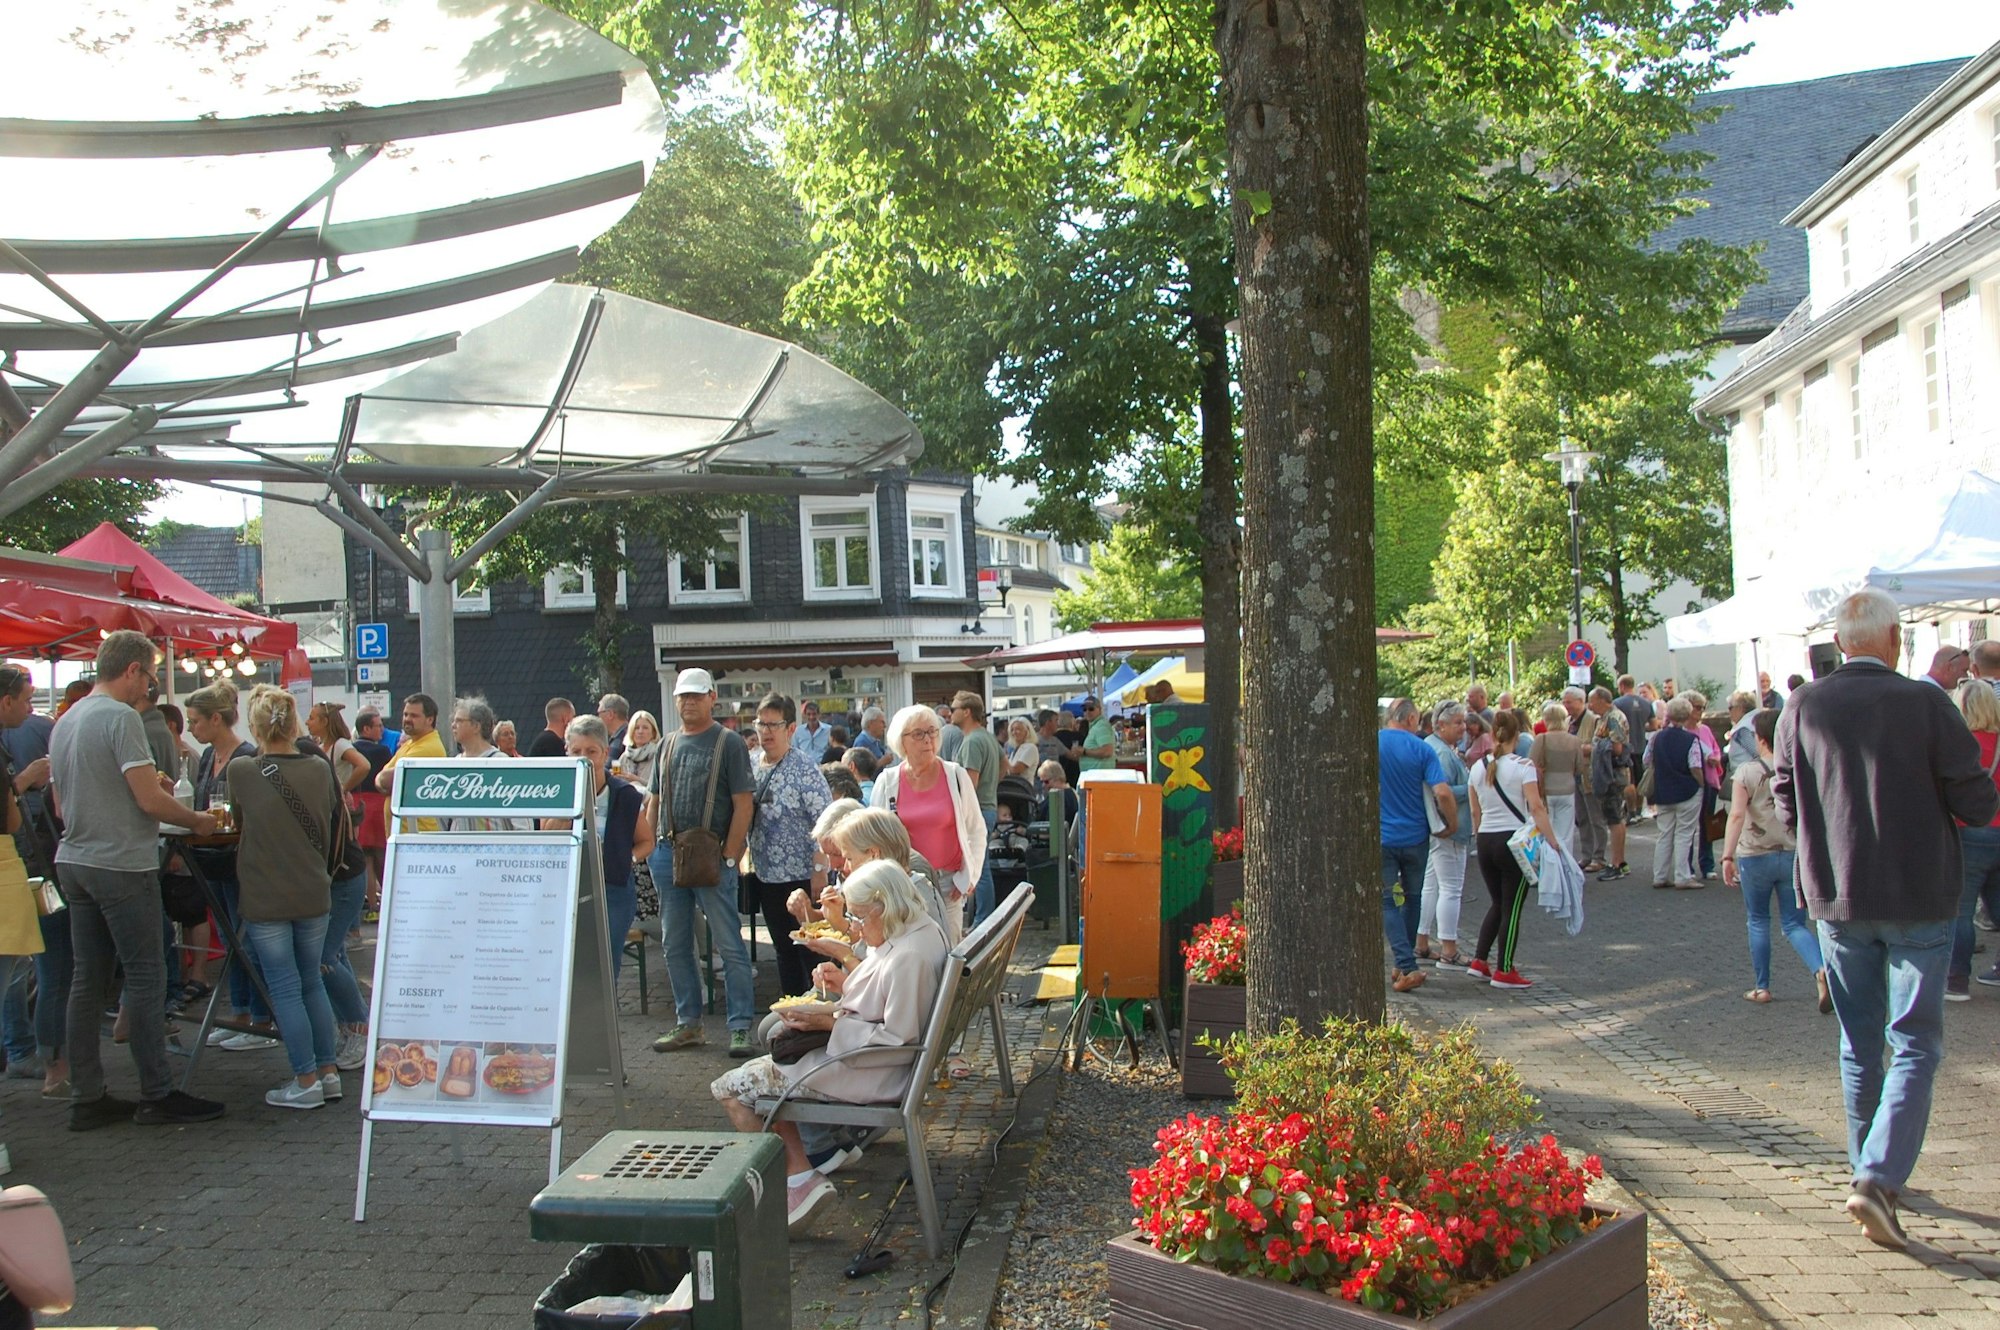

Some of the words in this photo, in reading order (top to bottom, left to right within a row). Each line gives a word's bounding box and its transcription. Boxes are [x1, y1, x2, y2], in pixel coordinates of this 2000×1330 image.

[361, 628, 378, 655] P
[416, 773, 460, 800] Eat
[452, 772, 561, 807] Portuguese
[407, 864, 457, 875] BIFANAS
[475, 858, 568, 870] PORTUGIESISCHE
[500, 873, 543, 884] SNACKS
[399, 987, 445, 998] DESSERT
